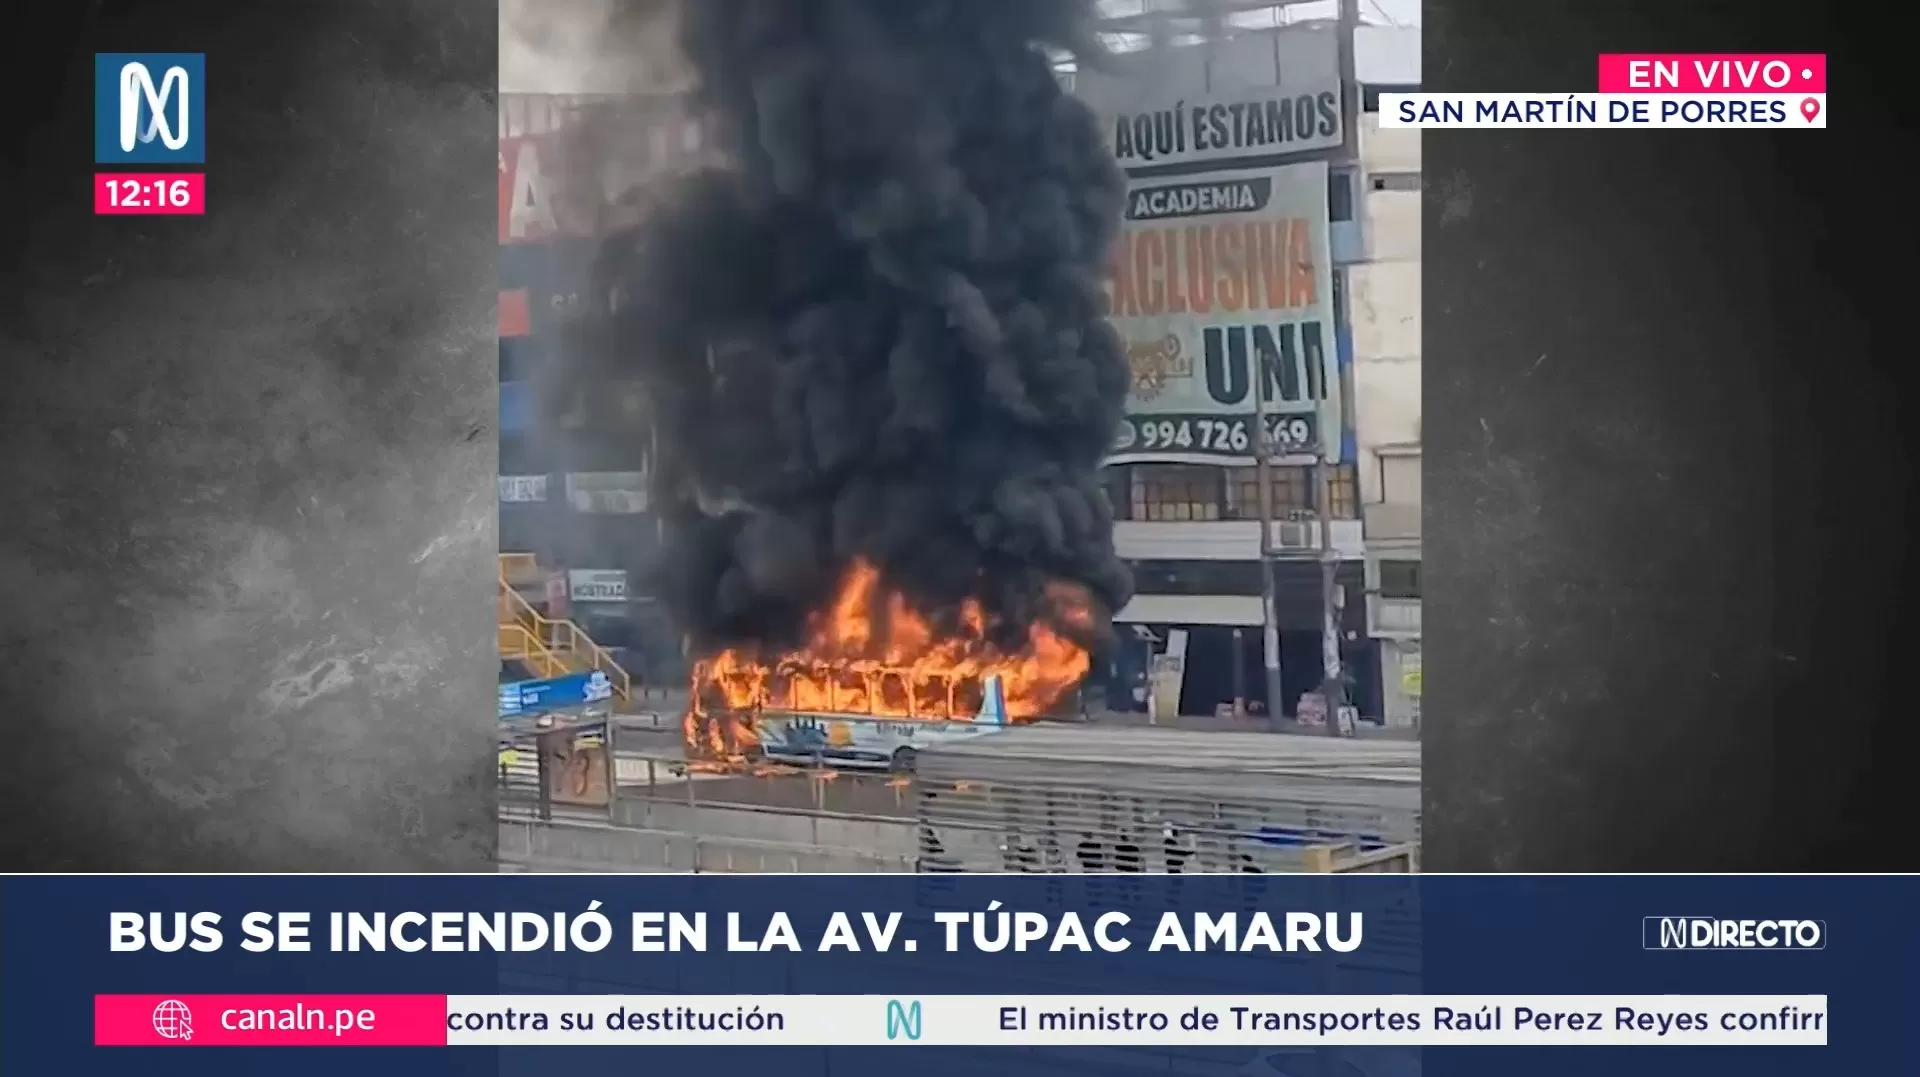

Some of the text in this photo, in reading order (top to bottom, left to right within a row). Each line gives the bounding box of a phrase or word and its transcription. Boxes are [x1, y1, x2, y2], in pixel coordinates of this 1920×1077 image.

[1115, 91, 1338, 161] AQUÍ ESTAMOS
[1133, 183, 1257, 218] ACADEMIA
[1109, 216, 1320, 318] XCLUSIVA
[1202, 321, 1328, 405] UNI
[1140, 419, 1193, 449] 994
[1196, 419, 1249, 451] 726
